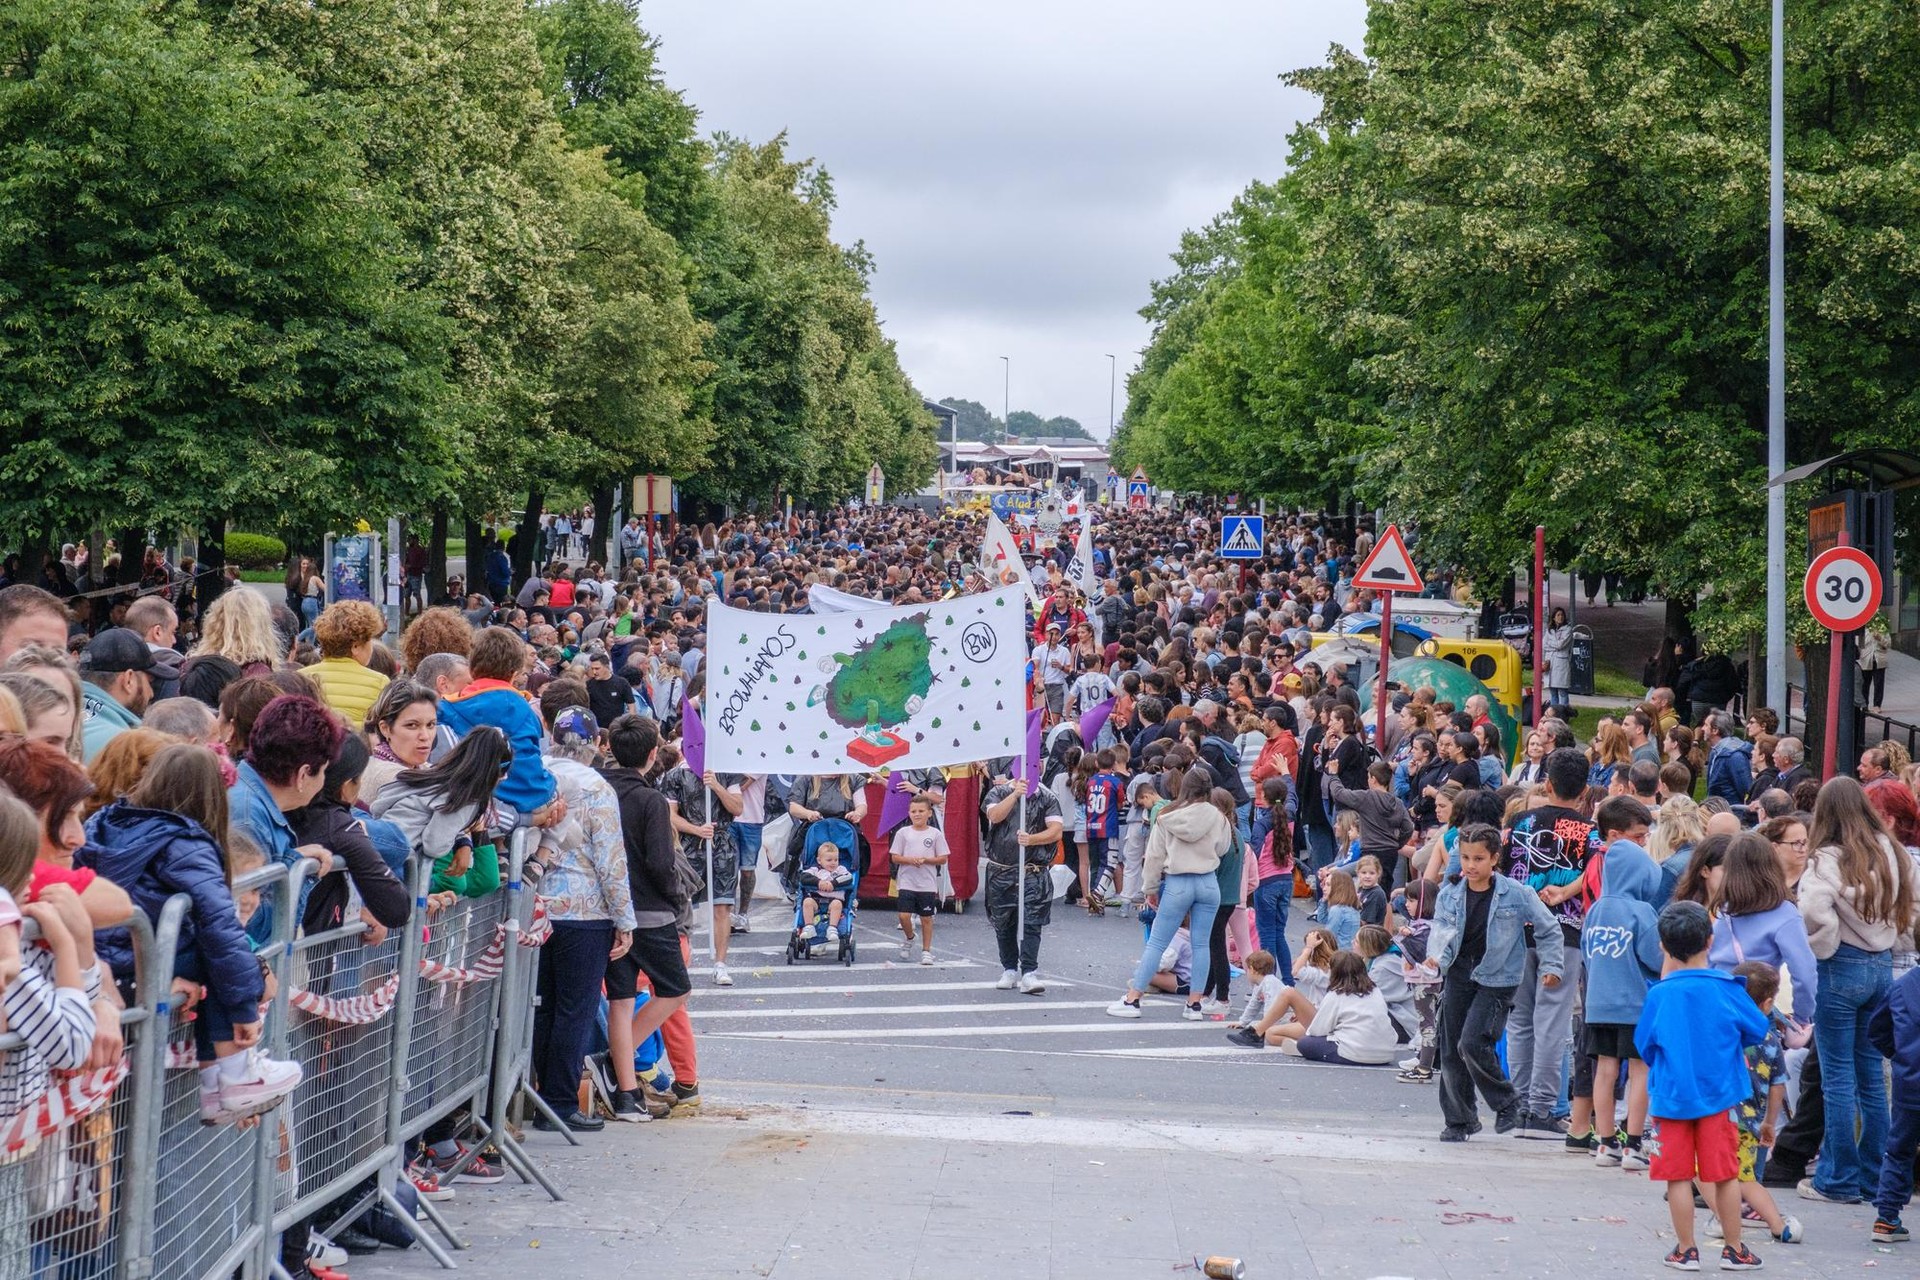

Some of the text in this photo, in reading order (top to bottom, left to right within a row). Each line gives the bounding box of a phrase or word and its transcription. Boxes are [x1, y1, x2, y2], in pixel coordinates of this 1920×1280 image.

[1824, 575, 1864, 603] 30
[964, 626, 992, 656] BW
[1462, 647, 1477, 655] 106
[1086, 684, 1101, 701] 10
[1087, 793, 1107, 814] 30
